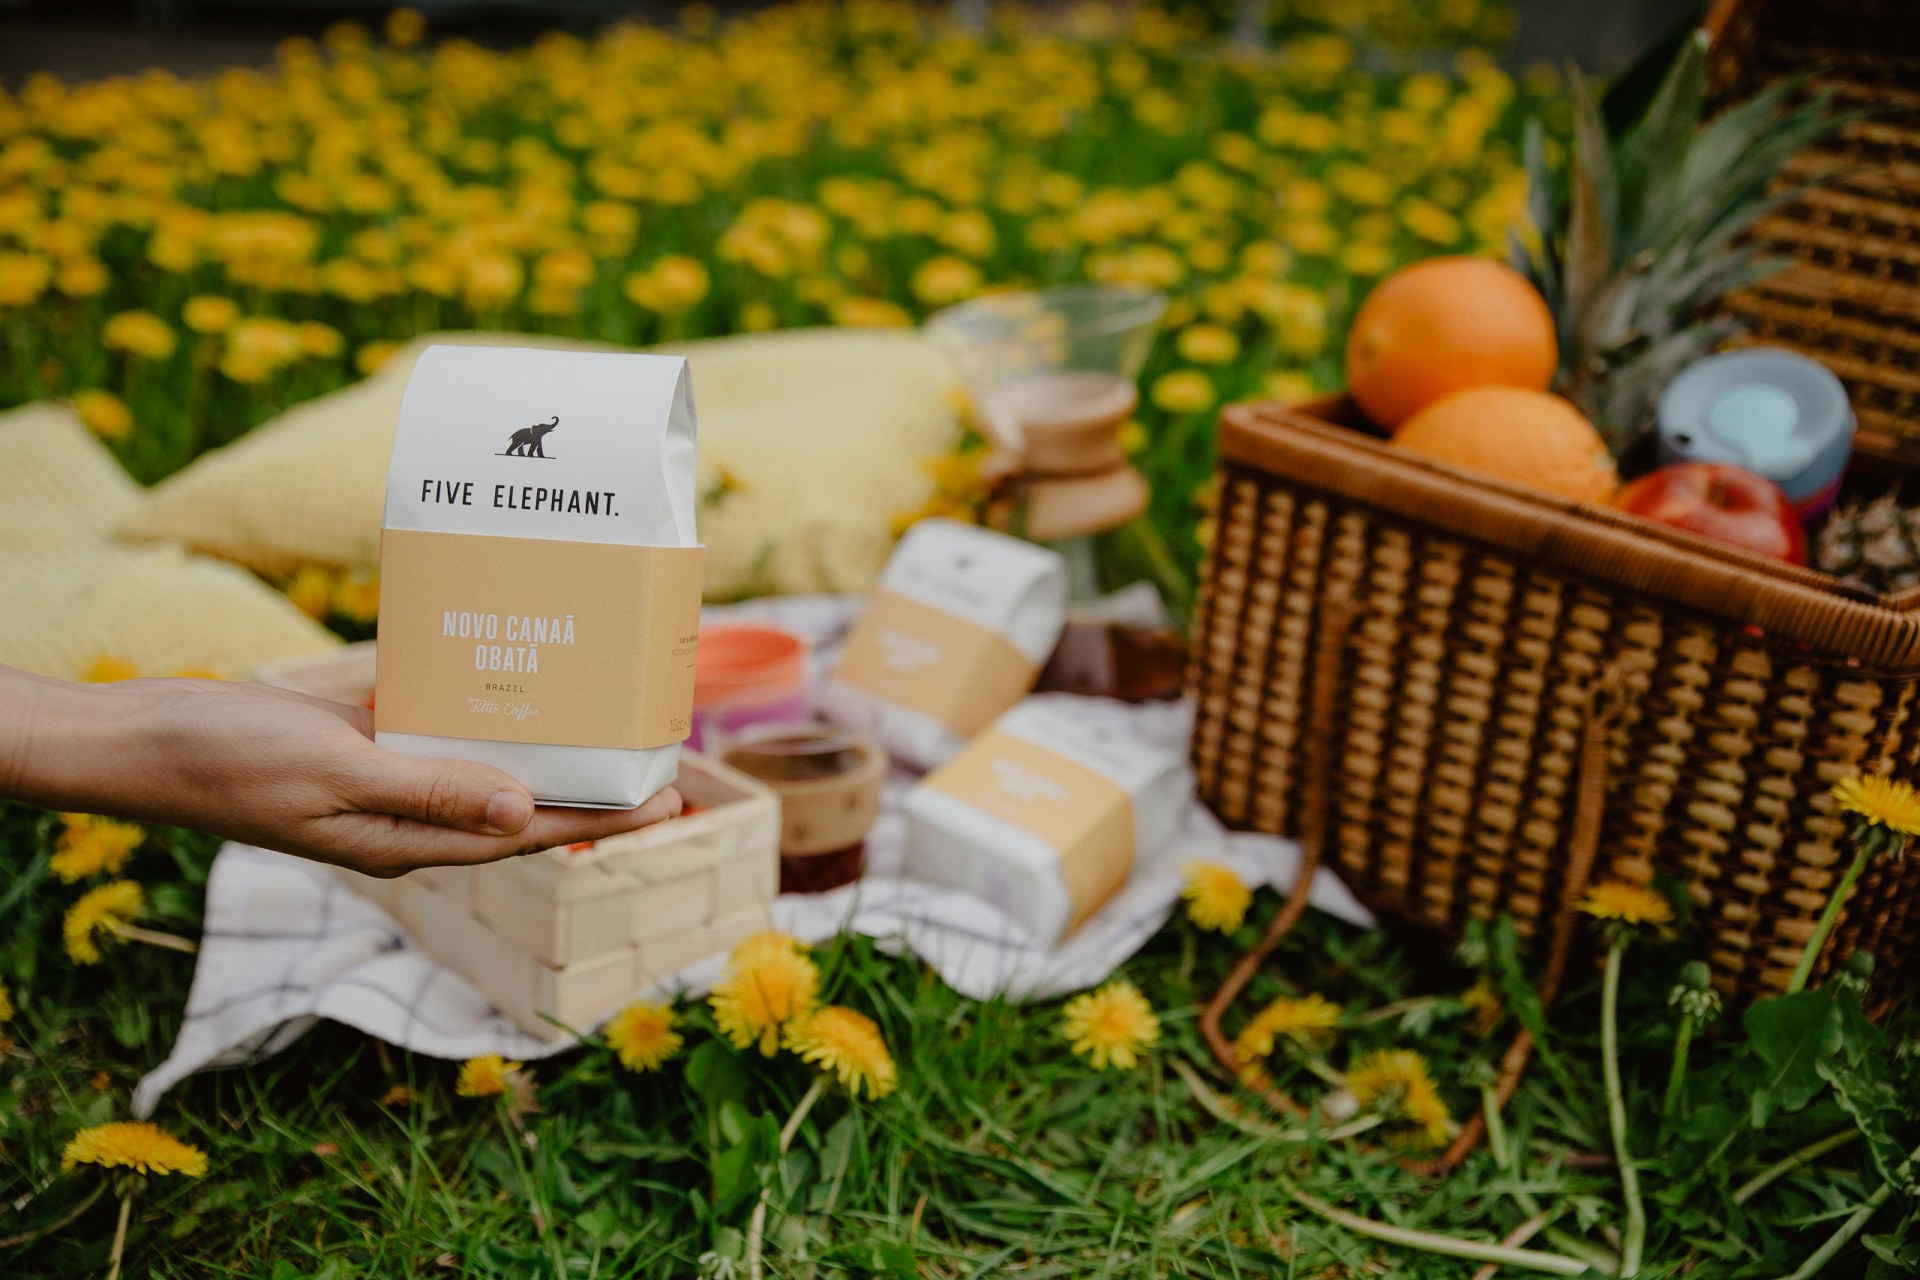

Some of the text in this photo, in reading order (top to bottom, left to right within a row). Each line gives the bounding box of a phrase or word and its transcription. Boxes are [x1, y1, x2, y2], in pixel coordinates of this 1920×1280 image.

[421, 479, 619, 517] FIVE ELEPHANT.
[443, 610, 575, 645] NOVO CANAÃ
[475, 643, 538, 673] OBATÃ
[485, 683, 525, 693] BRAZIL
[468, 696, 539, 721] Filter Coffee
